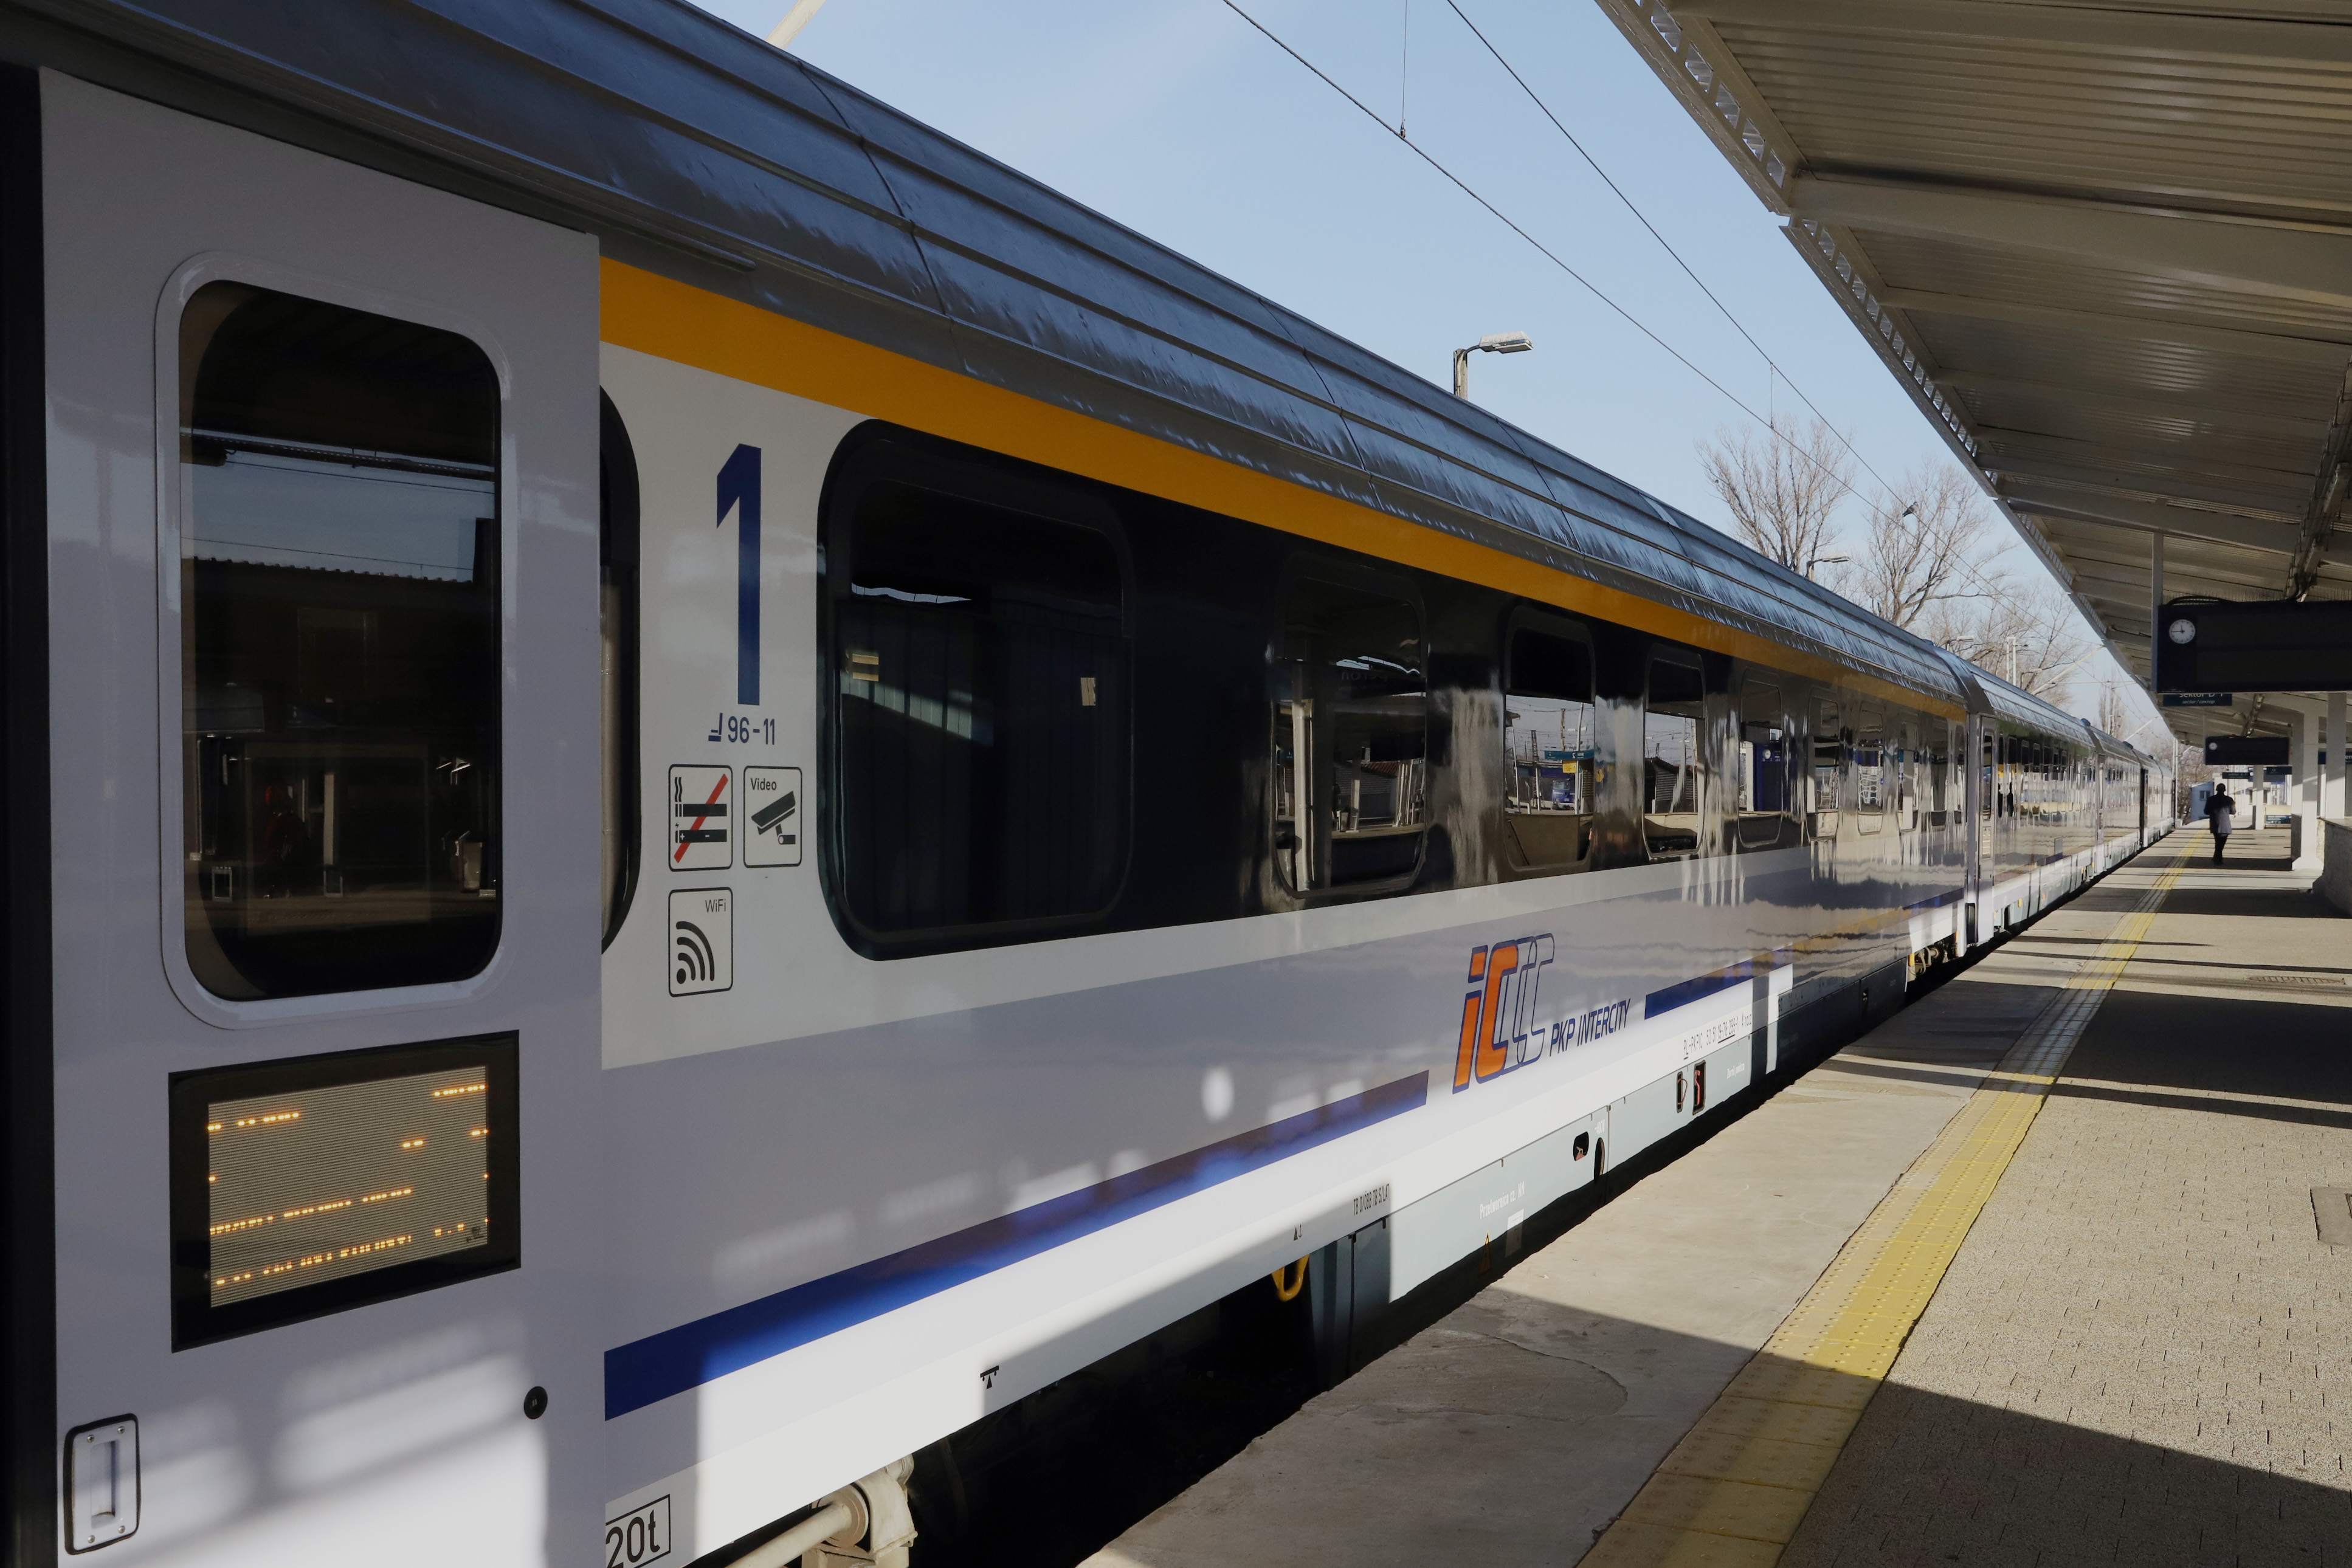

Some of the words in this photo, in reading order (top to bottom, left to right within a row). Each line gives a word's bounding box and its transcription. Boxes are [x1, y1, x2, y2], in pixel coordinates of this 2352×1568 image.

[717, 443, 762, 706] 1
[750, 777, 777, 791] Video
[705, 899, 726, 913] WiFi
[1550, 1018, 1576, 1057] PKP
[1577, 998, 1631, 1047] INTERCITY
[1354, 1198, 1359, 1216] TB
[1373, 1189, 1378, 1206] TB
[605, 1510, 661, 1568] 20t
